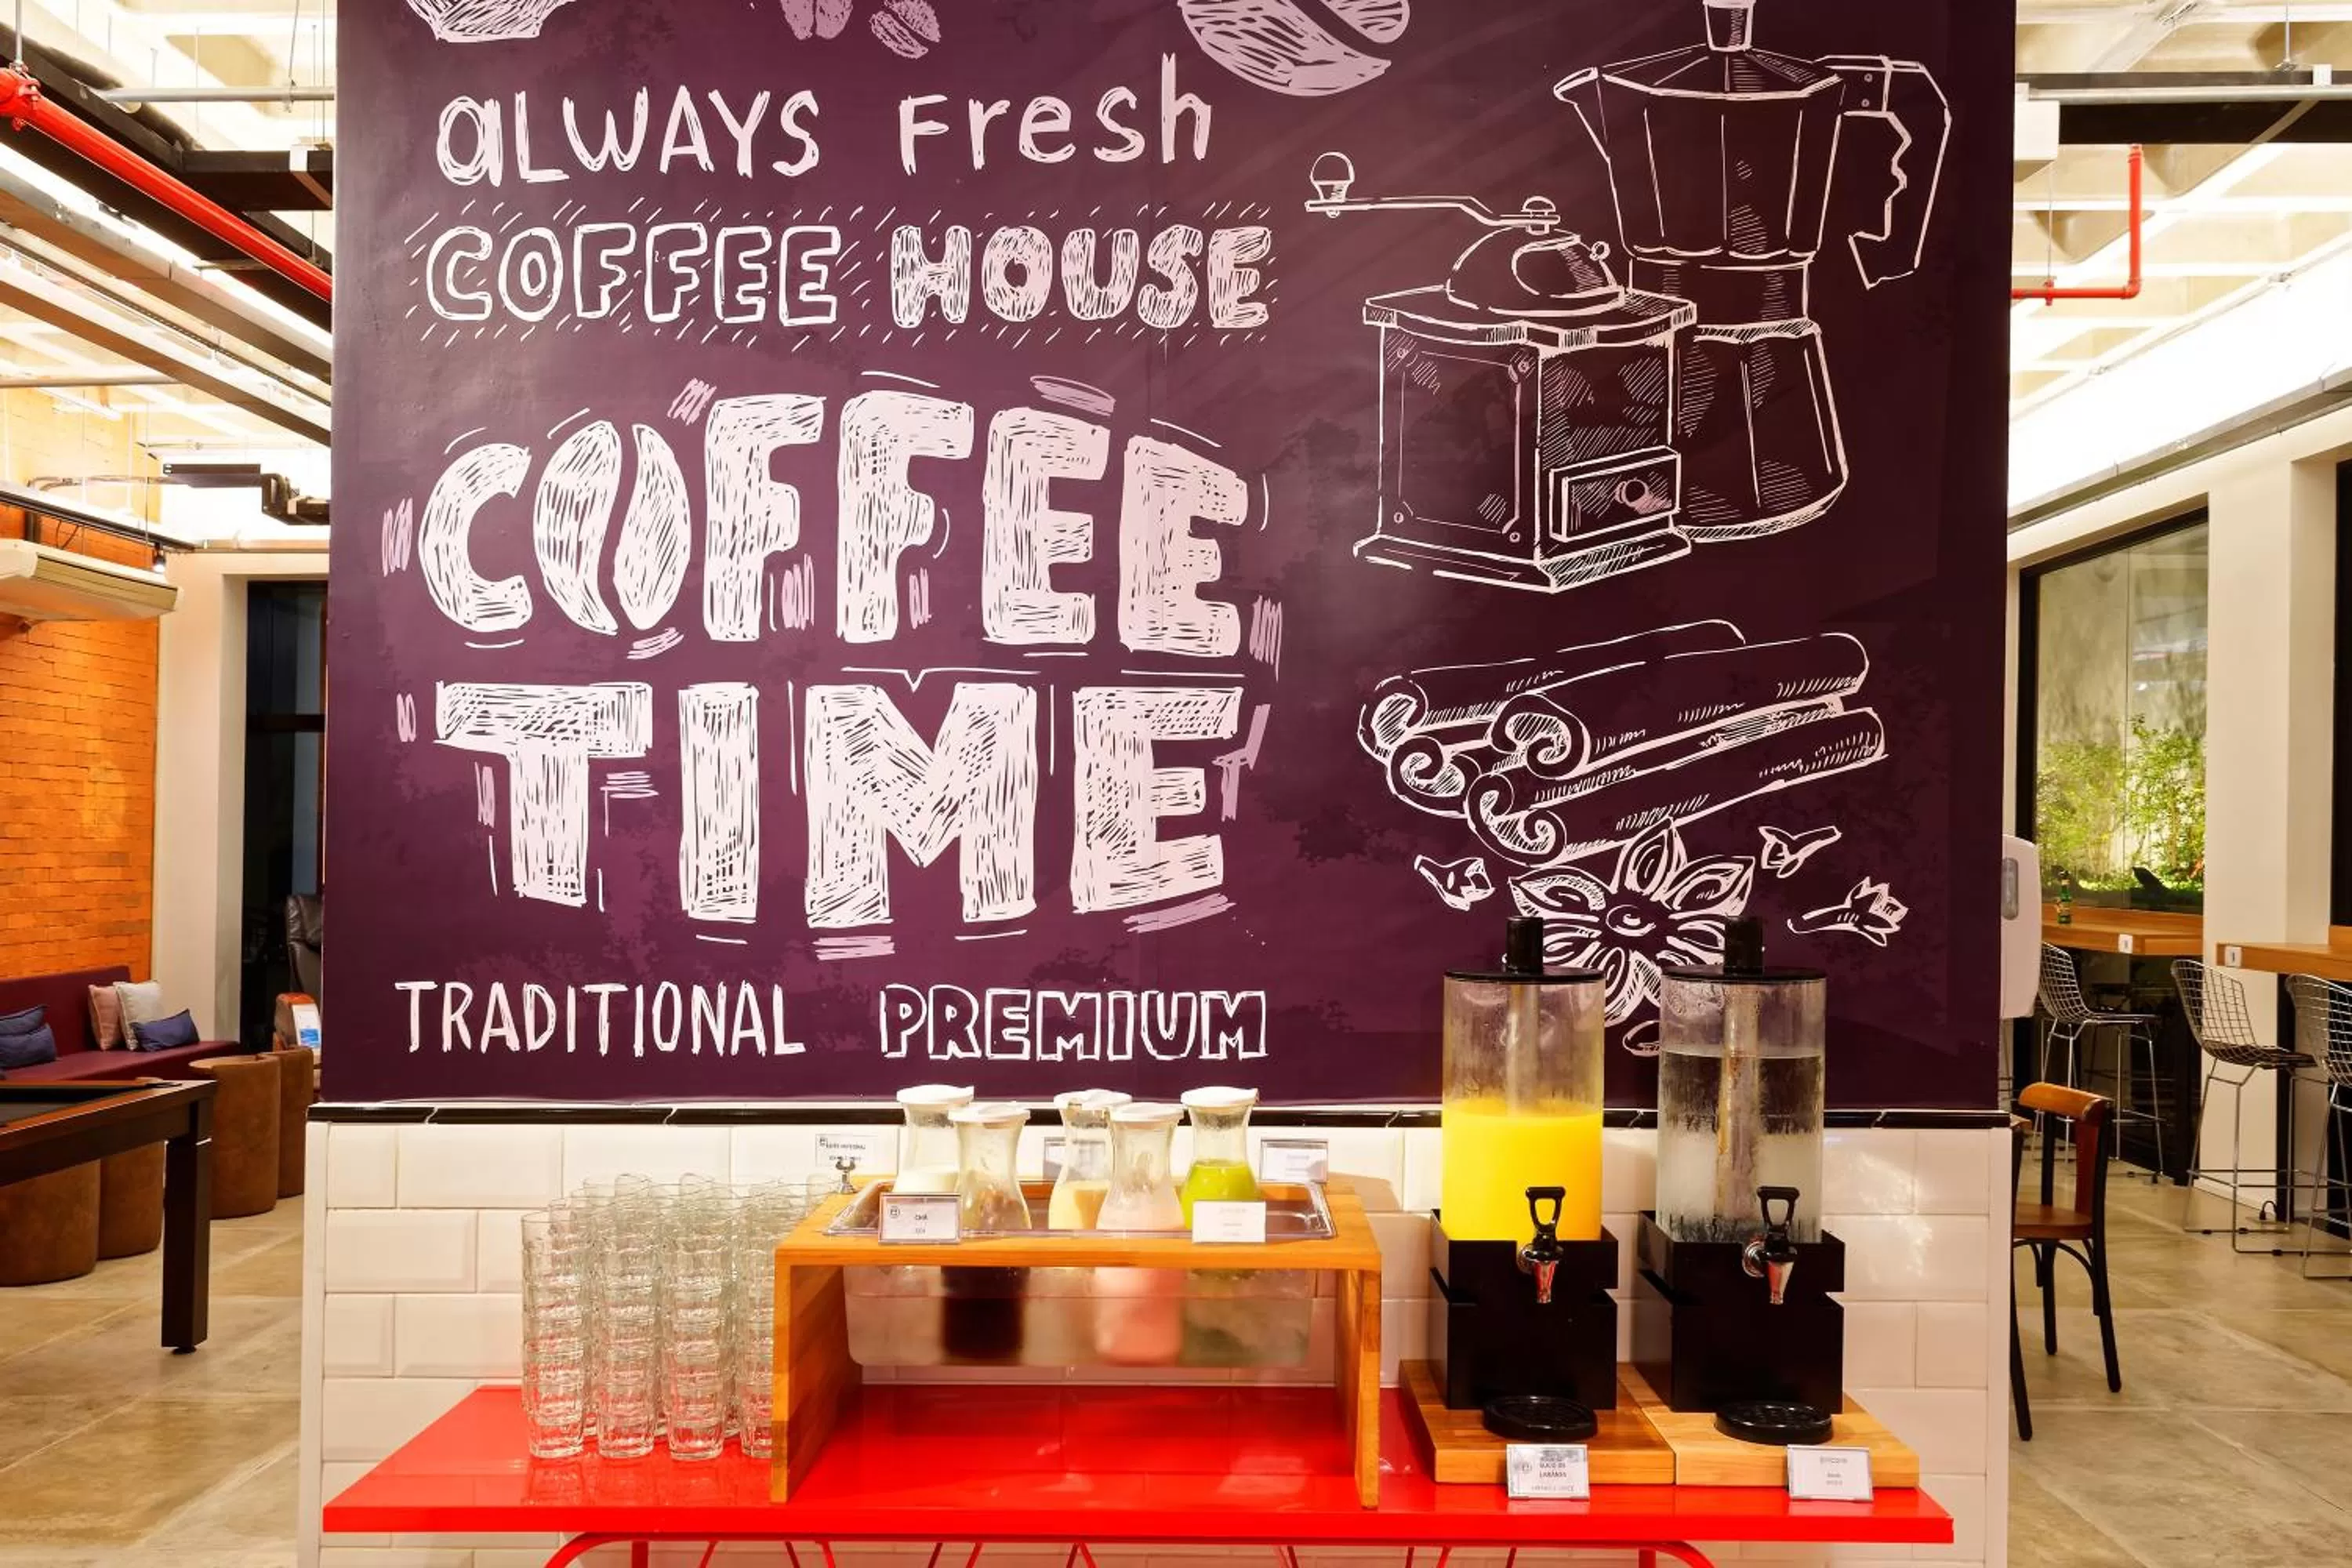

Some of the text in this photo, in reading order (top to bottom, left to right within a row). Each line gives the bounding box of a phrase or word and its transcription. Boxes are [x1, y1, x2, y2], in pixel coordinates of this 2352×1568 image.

[424, 220, 1272, 331] COFFEE HOUSE
[418, 387, 1249, 657] COFFEE
[432, 681, 1244, 929] TIME
[394, 981, 1269, 1061] TRADITIONAL PREMIUM
